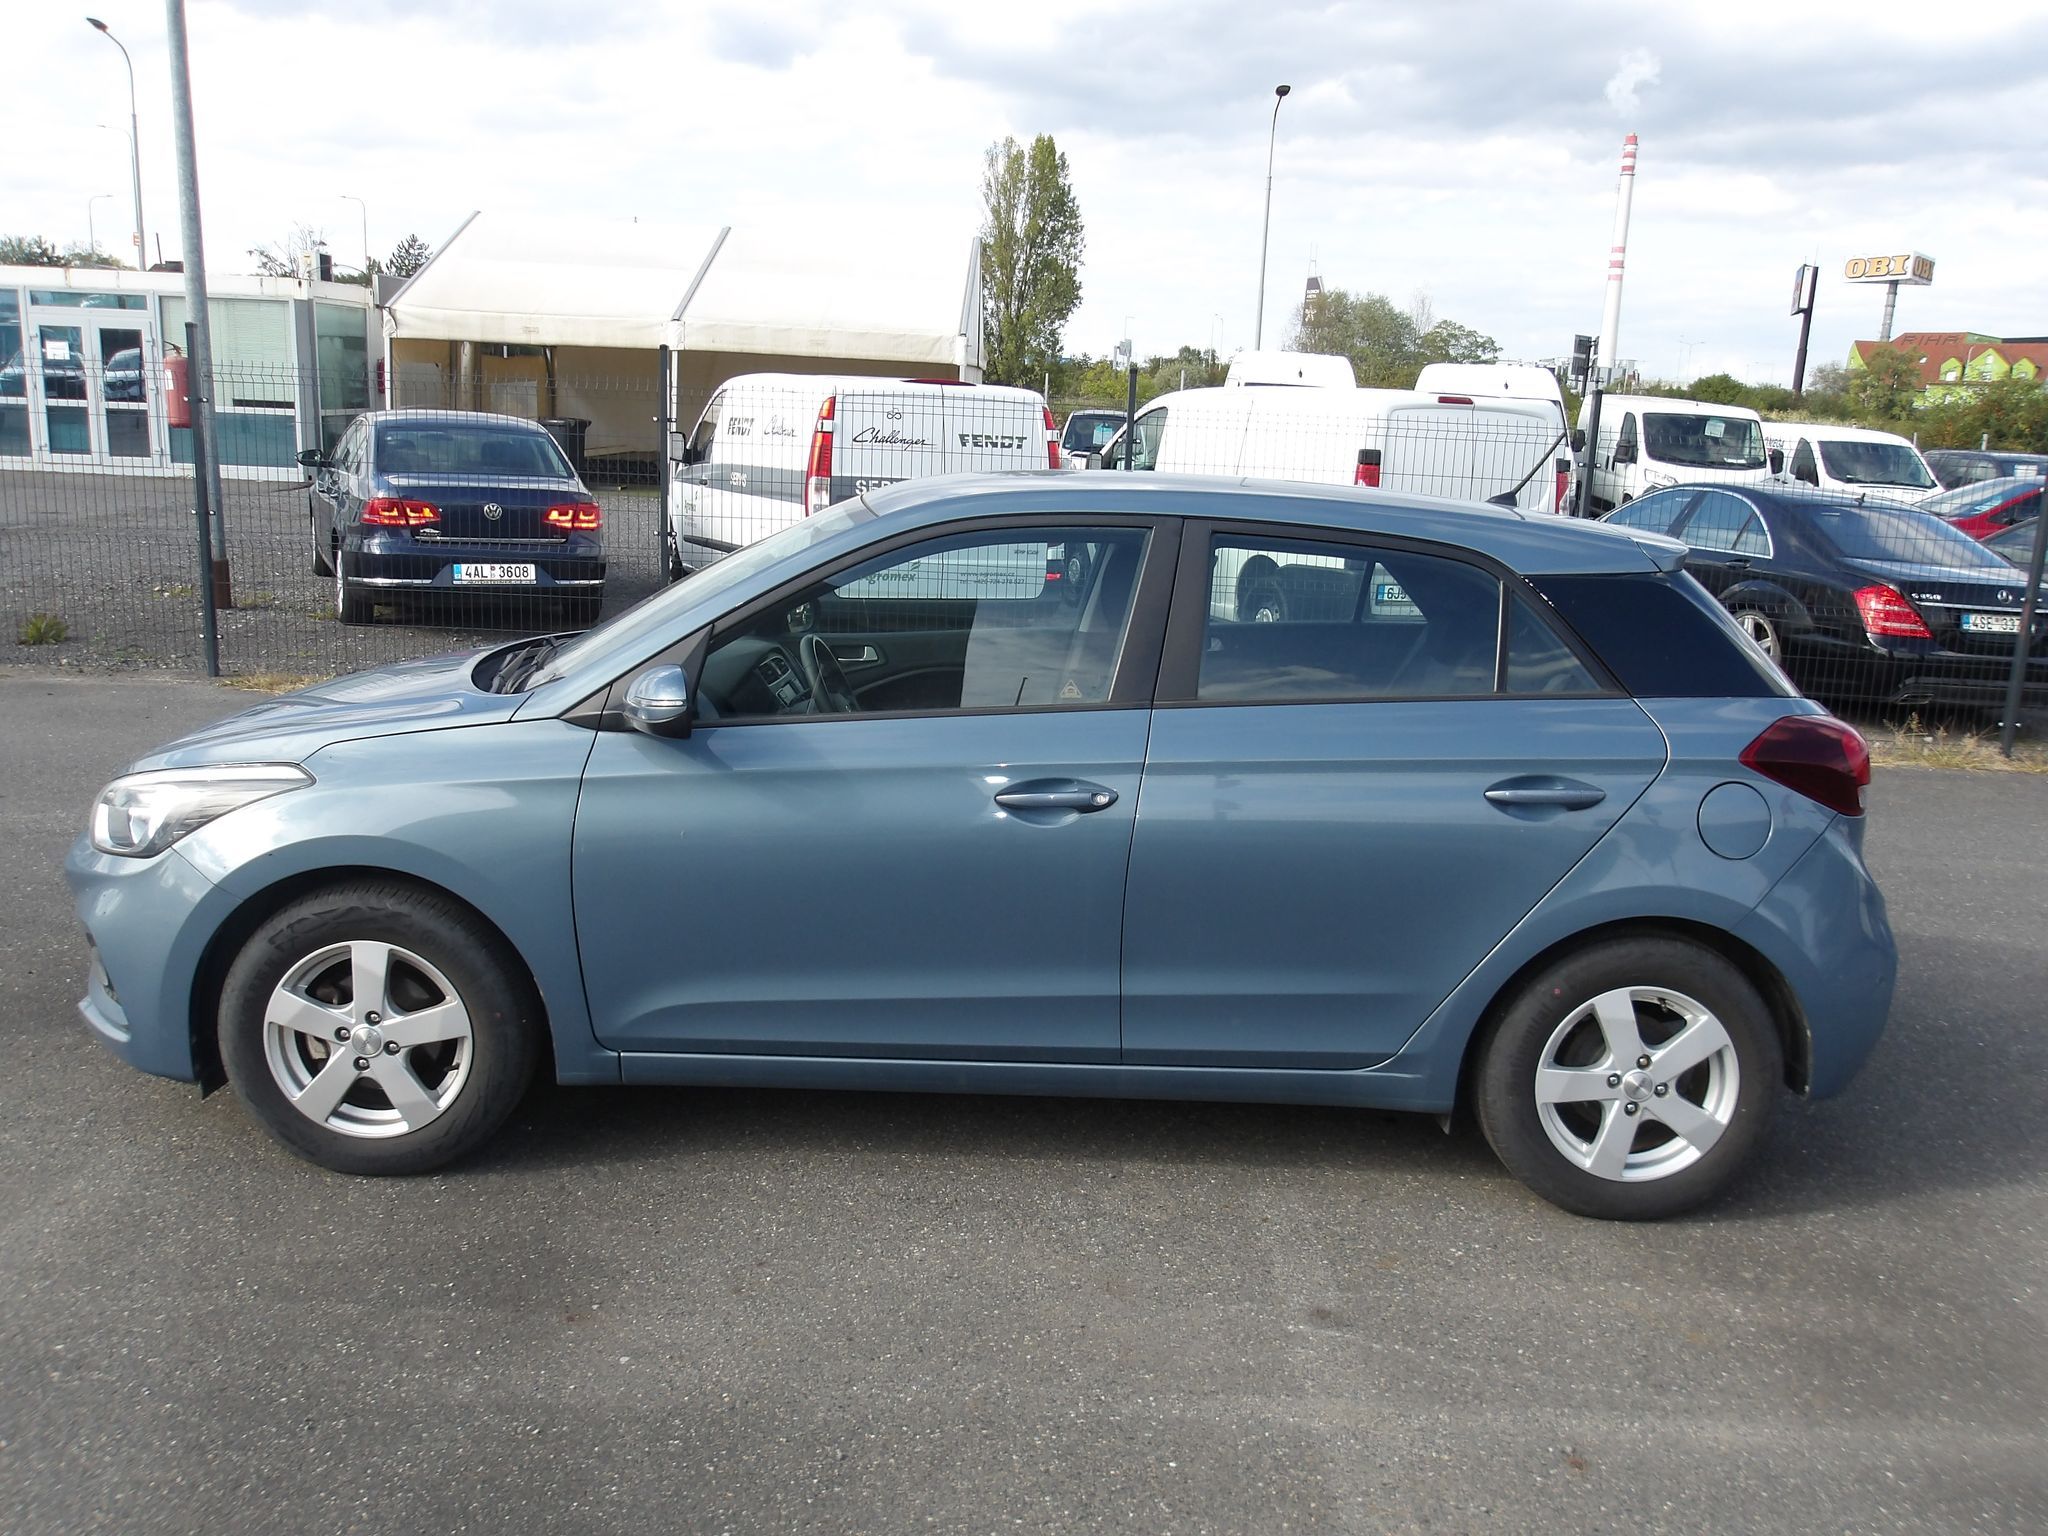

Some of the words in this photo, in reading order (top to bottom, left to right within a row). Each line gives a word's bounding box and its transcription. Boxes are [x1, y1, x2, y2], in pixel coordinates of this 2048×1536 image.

[1845, 255, 1910, 278] OBI
[852, 427, 937, 451] Challenger
[958, 433, 1028, 450] FENDT
[465, 566, 488, 579] 4AL
[498, 566, 529, 578] 3608
[1972, 616, 1993, 630] 4SE
